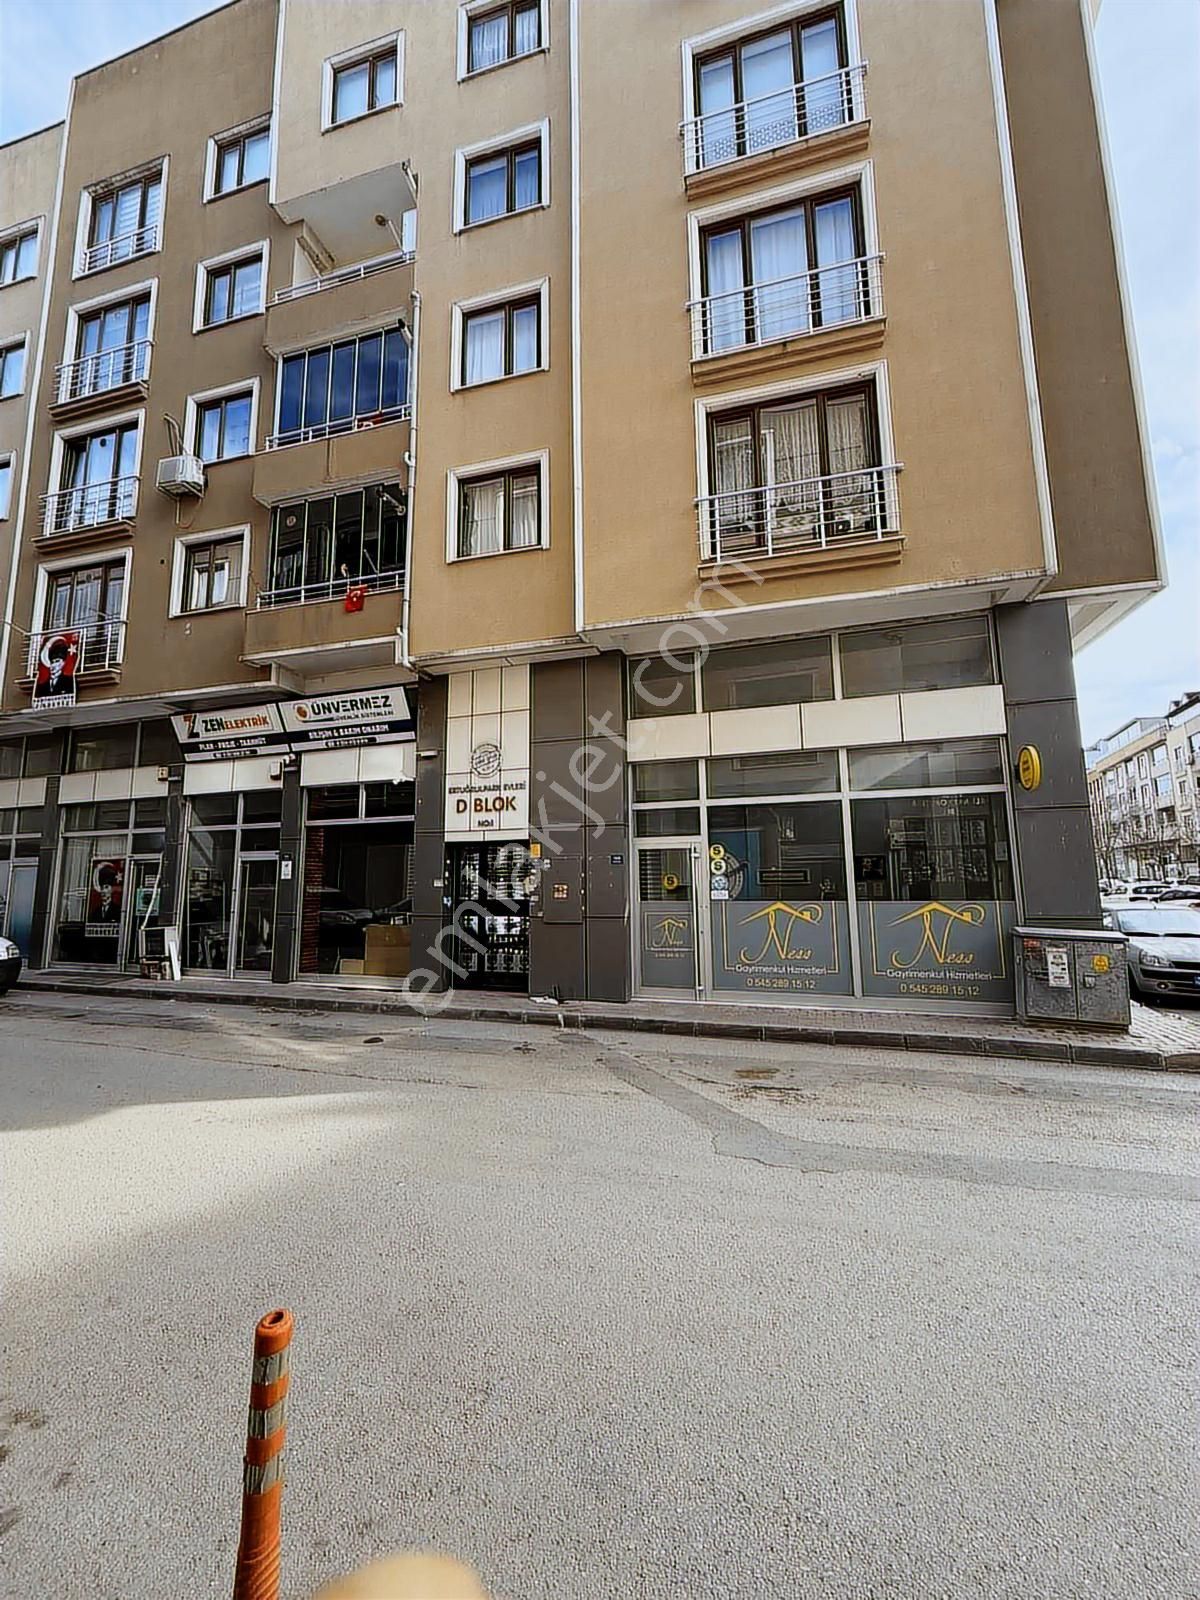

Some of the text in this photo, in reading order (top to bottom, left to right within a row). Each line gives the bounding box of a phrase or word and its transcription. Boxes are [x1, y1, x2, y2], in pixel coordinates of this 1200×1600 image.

[311, 695, 393, 716] ÜNVERMEZ
[456, 796, 517, 814] D BLOK
